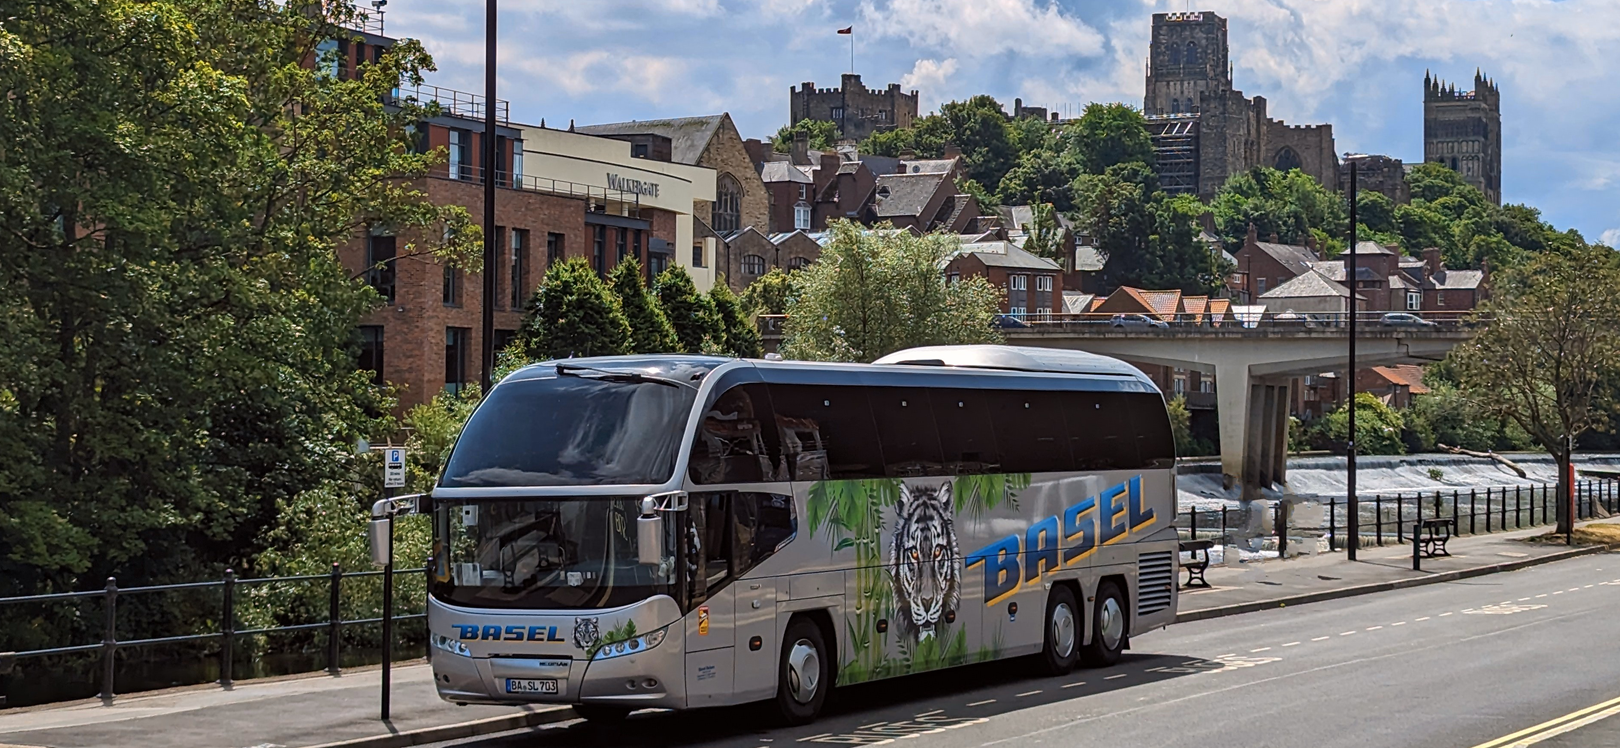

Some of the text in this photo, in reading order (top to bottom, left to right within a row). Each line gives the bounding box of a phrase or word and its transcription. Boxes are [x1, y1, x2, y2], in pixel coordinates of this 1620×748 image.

[606, 172, 660, 198] WALKERGATE
[965, 474, 1157, 608] BASEL
[451, 624, 565, 643] BASEL
[511, 680, 556, 691] BA SL 703
[810, 715, 990, 746] BUSES
